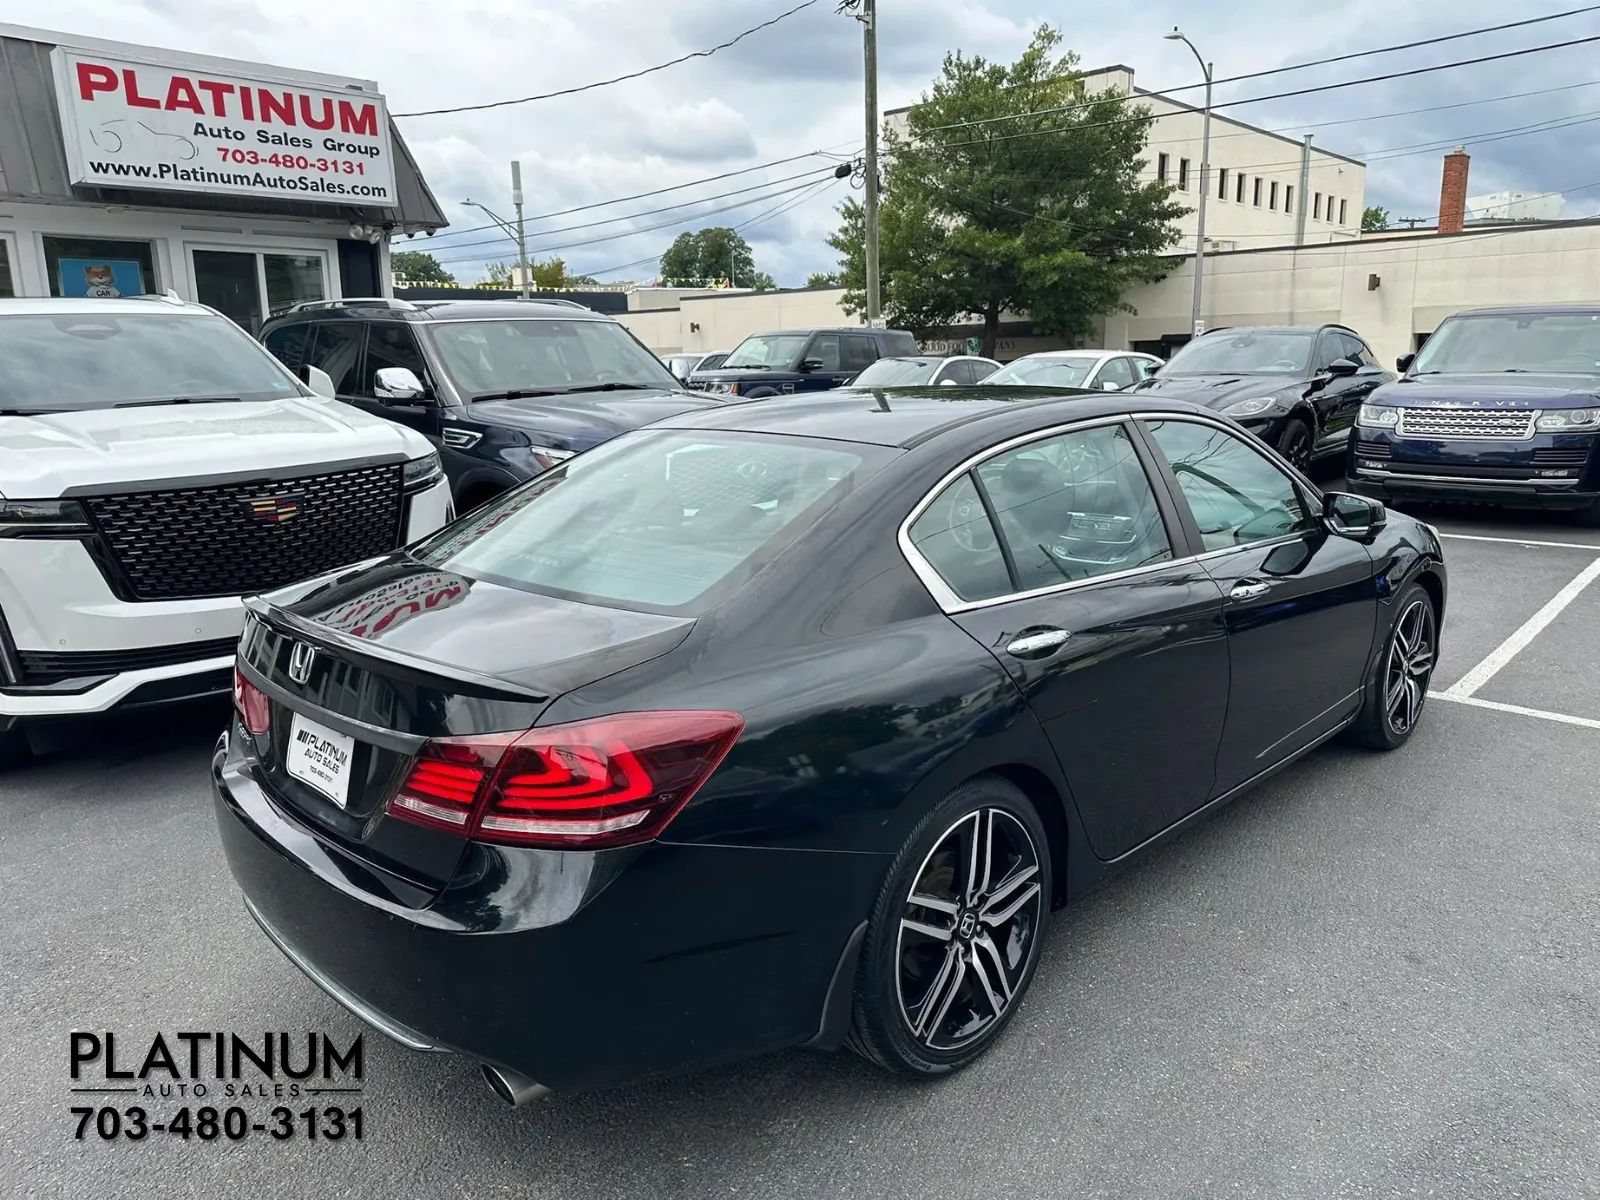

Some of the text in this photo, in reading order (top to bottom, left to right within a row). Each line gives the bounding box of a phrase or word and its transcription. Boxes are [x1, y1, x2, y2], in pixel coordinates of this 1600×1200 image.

[76, 62, 379, 137] PLATINUM
[193, 121, 380, 158] Auto Sales Group
[89, 160, 387, 198] www.PlatinumAutoSales.com
[216, 147, 365, 176] 703-480-3131
[304, 748, 340, 774] AUTO SALES
[307, 733, 348, 766] PLATINUM
